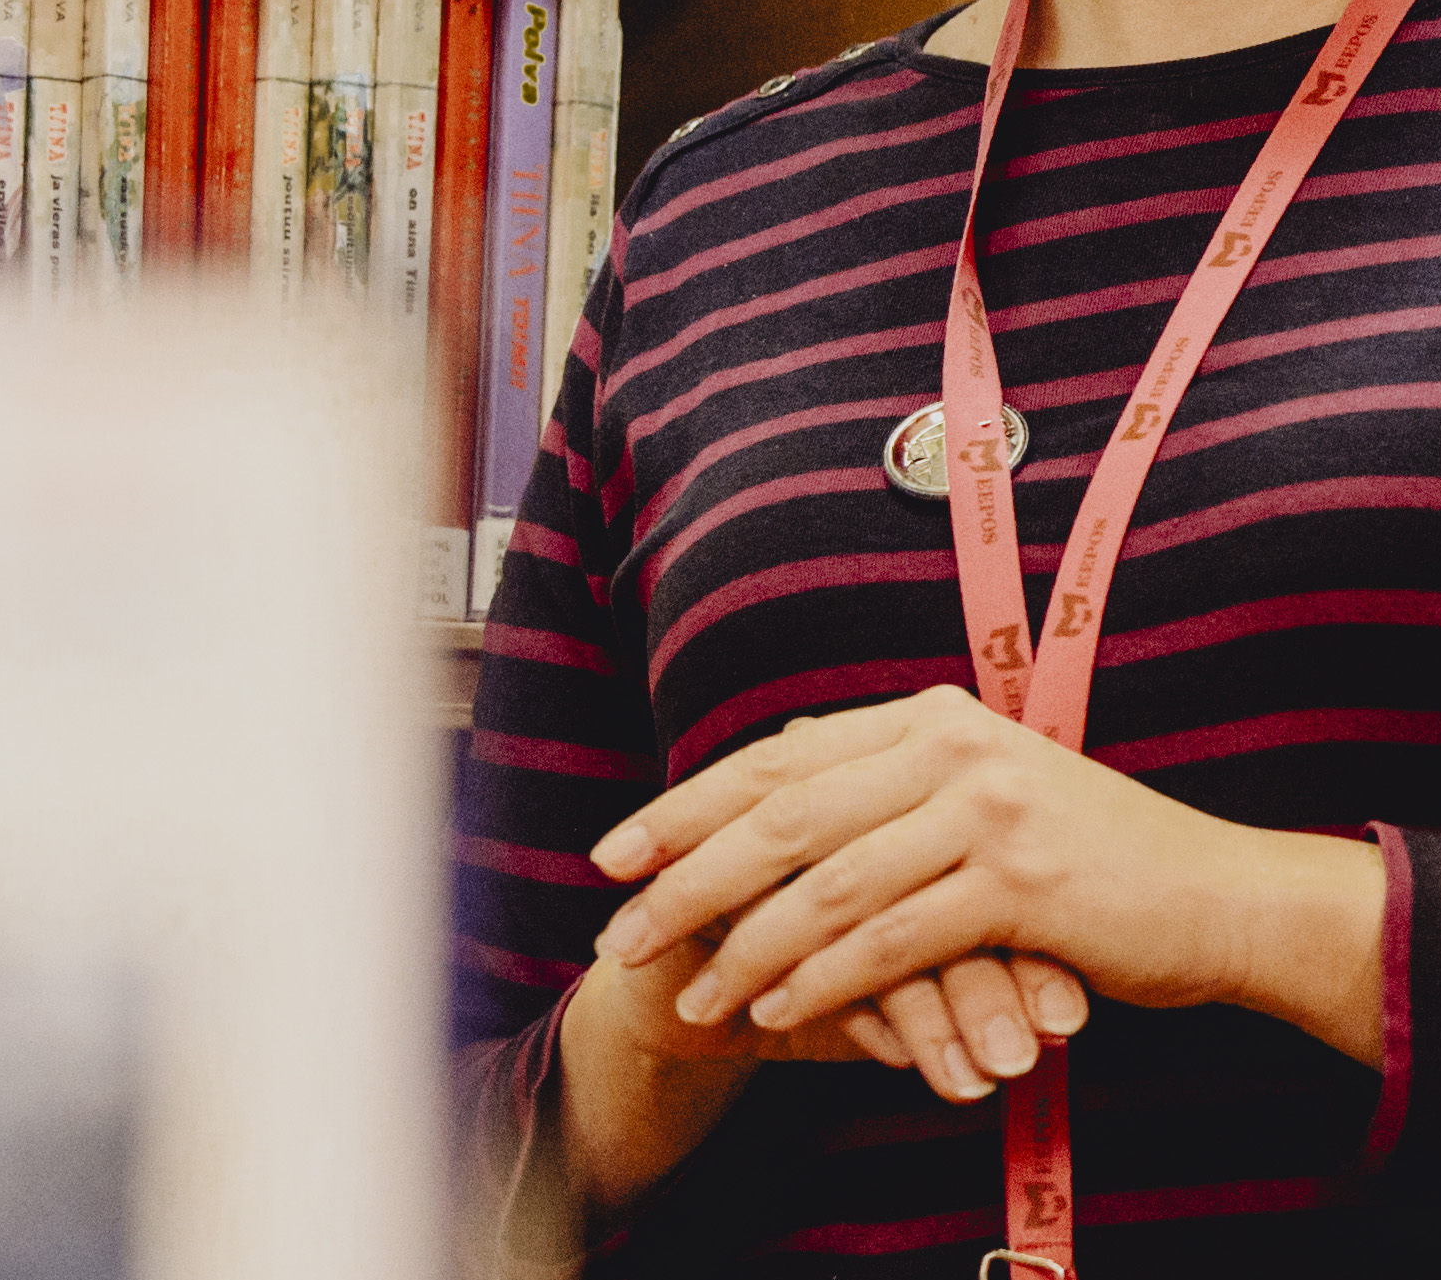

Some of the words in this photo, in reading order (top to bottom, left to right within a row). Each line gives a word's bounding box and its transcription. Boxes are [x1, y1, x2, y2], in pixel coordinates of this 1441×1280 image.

[520, 3, 549, 106] Polva
[48, 102, 68, 162] TIINA
[50, 175, 64, 191] ja
[281, 175, 296, 241] joutuu
[407, 187, 419, 210] on
[1240, 170, 1283, 228] EEPOS
[52, 197, 64, 250] vieras
[406, 220, 419, 258] aina
[508, 168, 544, 279] TIINA
[1149, 337, 1189, 398] EEPOS
[976, 478, 998, 546] EEPOS
[1076, 519, 1107, 588] EEPOS
